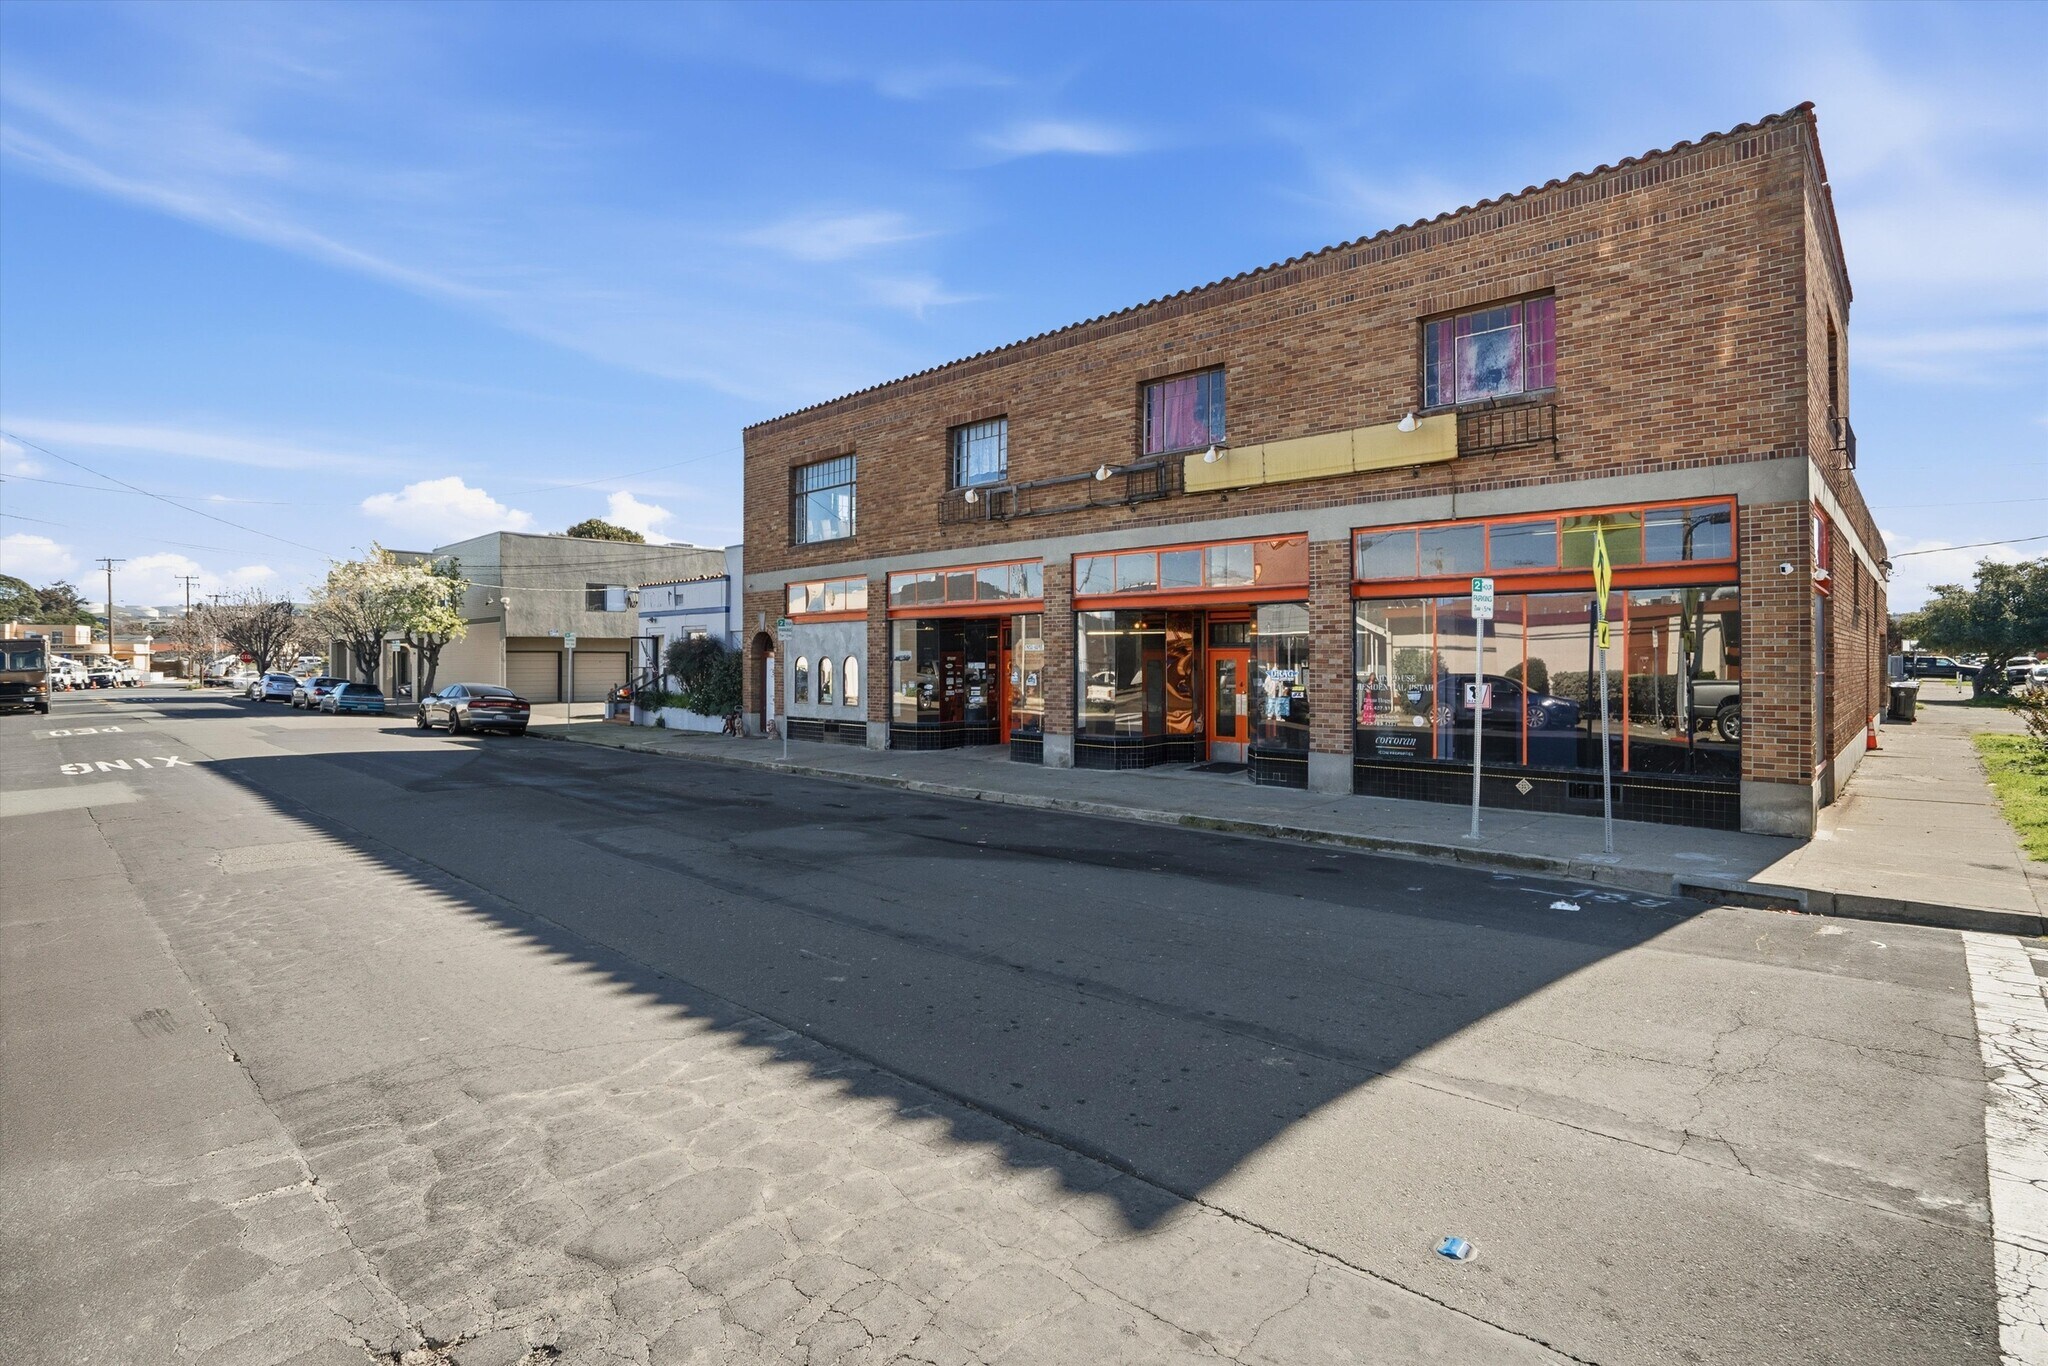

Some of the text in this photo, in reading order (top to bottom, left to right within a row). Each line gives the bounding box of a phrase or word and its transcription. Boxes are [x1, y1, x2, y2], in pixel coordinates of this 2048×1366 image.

[1474, 581, 1481, 590] 2
[1401, 674, 1416, 682] USE
[1356, 683, 1406, 691] RESIDENIAL
[49, 725, 124, 737] PED
[1375, 736, 1417, 746] corcoran
[59, 755, 195, 775] XING
